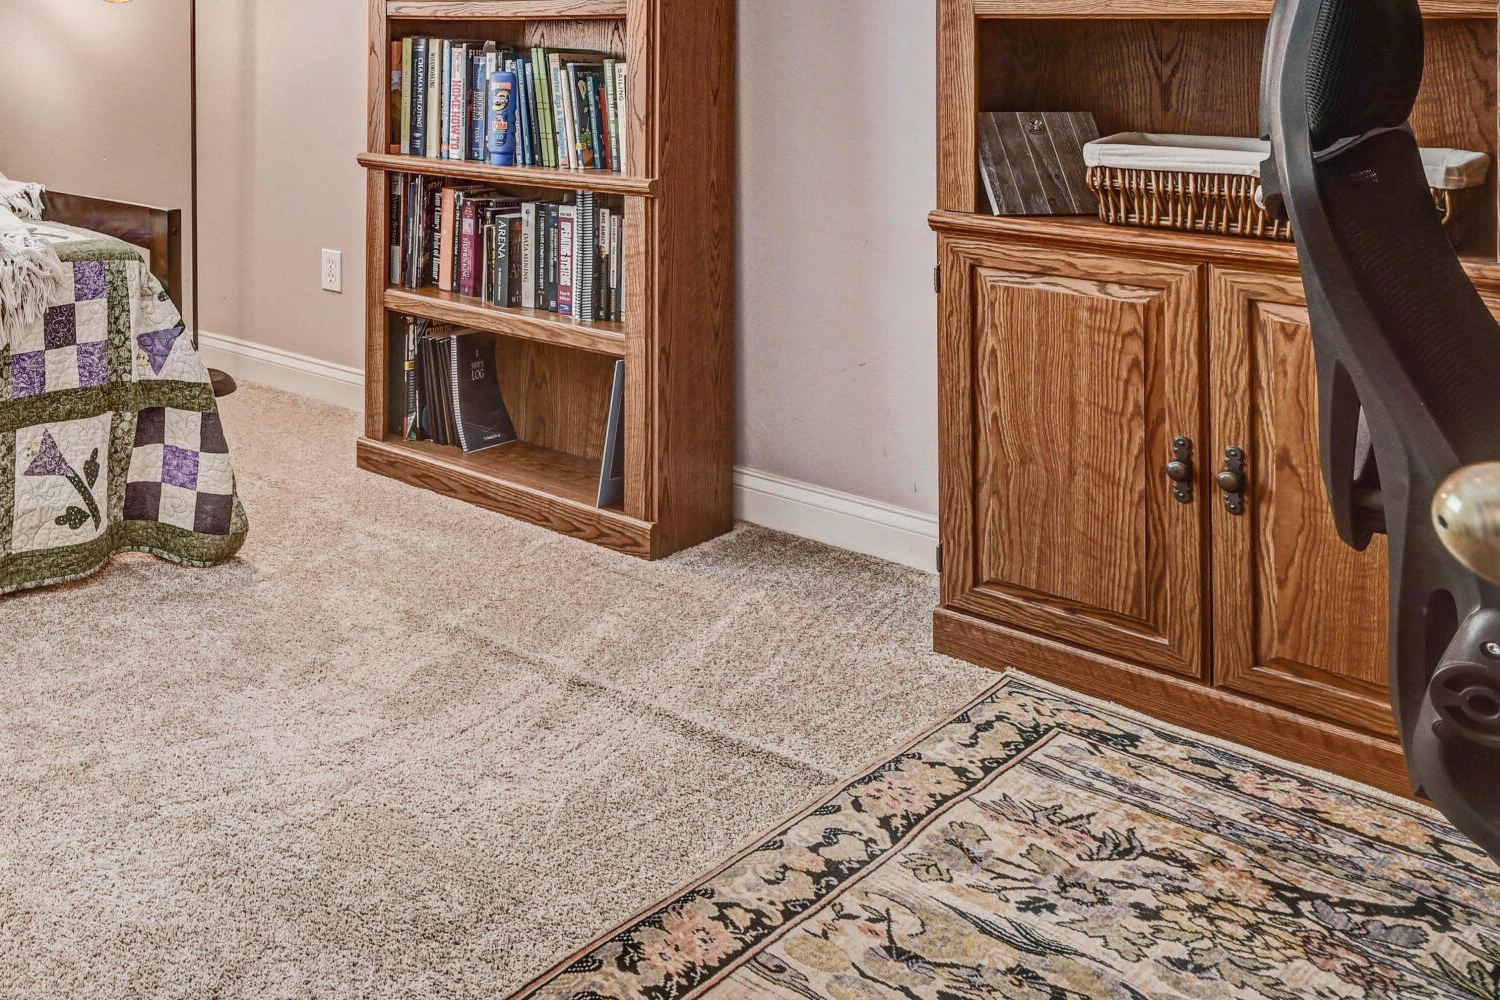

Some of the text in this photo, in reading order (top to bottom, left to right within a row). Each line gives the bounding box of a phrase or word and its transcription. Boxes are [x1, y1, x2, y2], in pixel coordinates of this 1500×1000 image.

[452, 80, 461, 110] HOME
[617, 68, 625, 102] SAILING
[497, 220, 507, 259] ARENA
[560, 221, 572, 255] OPERATING
[432, 257, 440, 279] Honor
[560, 256, 571, 287] SYSTEMS
[471, 369, 485, 380] LOG
